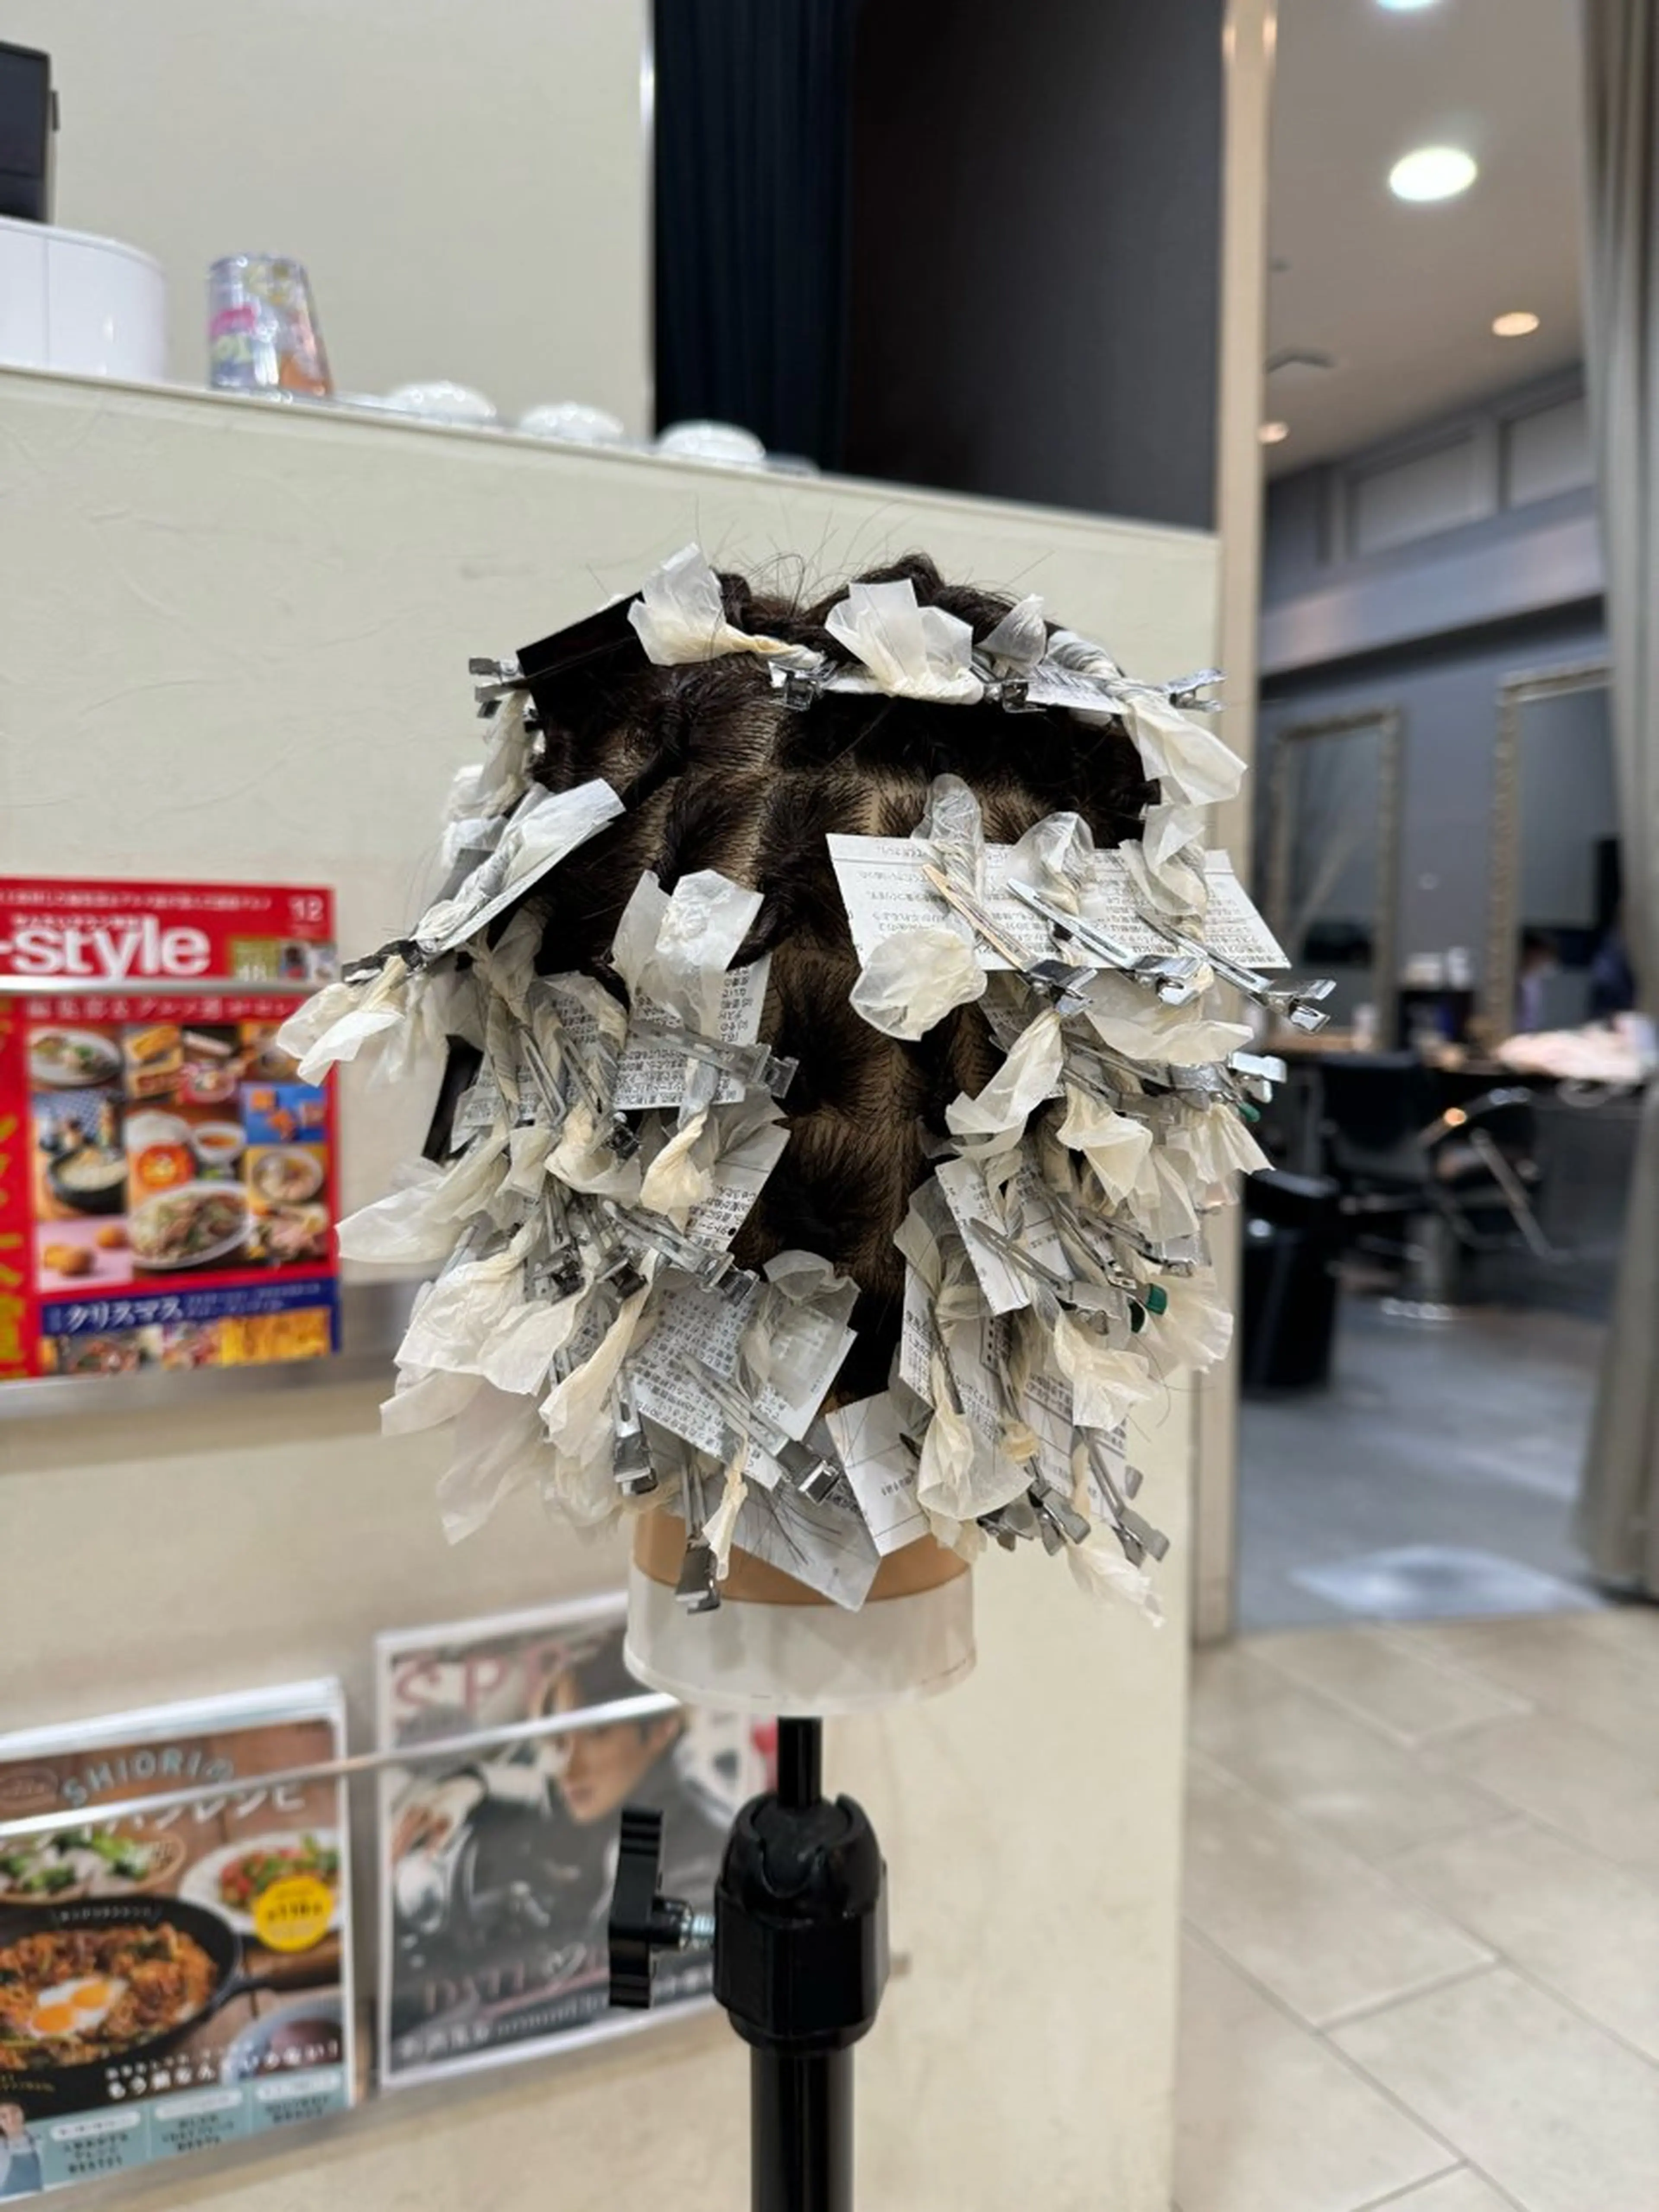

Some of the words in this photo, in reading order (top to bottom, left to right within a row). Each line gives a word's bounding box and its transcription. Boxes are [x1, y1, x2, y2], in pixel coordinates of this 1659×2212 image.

[289, 894, 323, 922] 12
[66, 1295, 183, 1333] クリスマス
